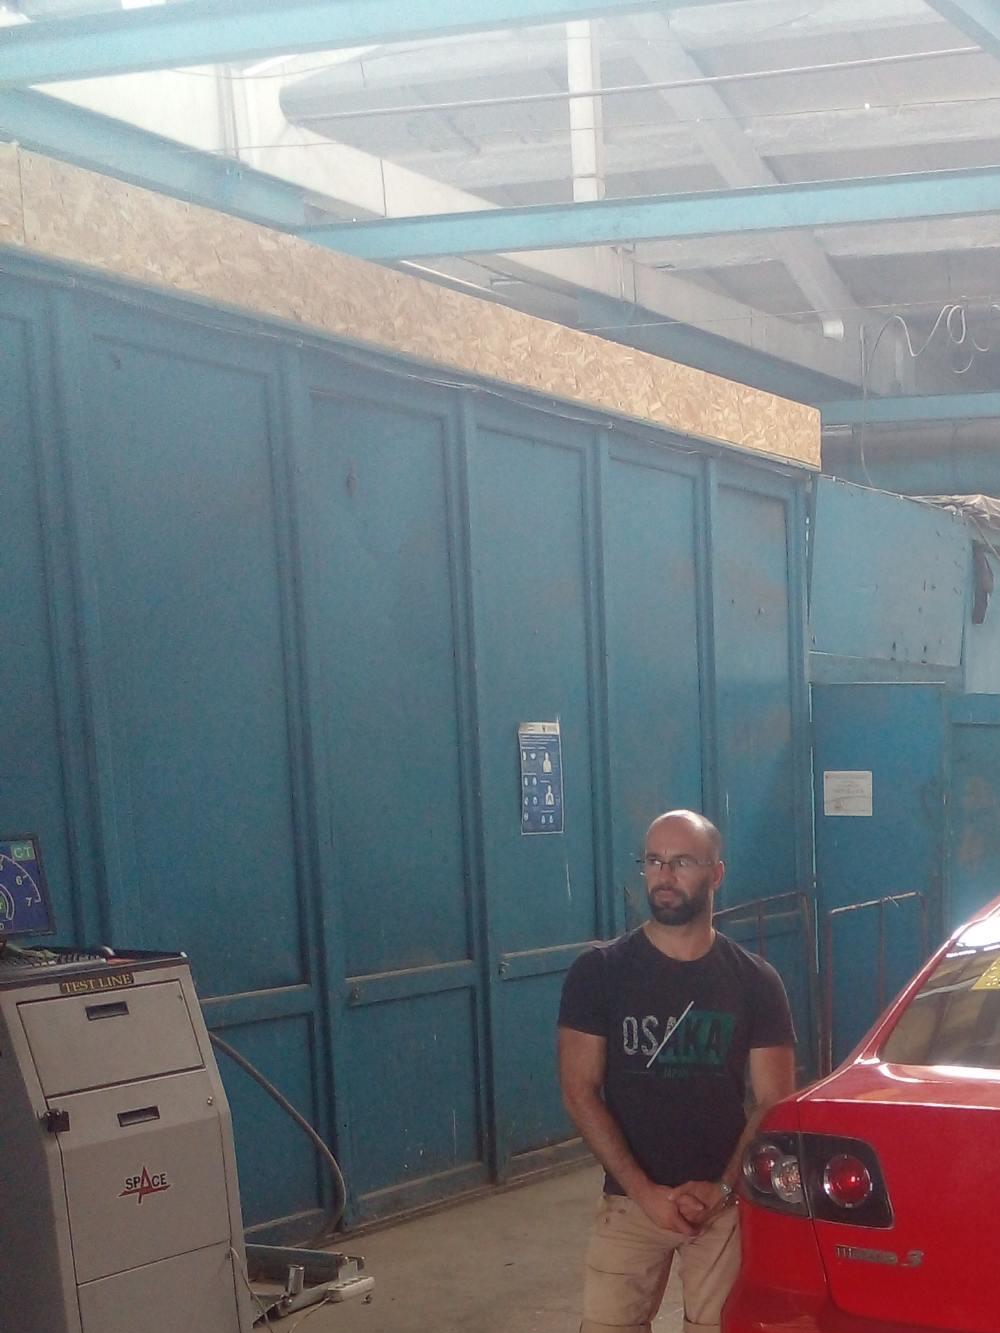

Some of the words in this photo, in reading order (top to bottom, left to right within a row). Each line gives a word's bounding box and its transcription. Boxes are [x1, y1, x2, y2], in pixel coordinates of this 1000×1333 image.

[16, 875, 23, 886] 6
[26, 896, 33, 907] 7
[62, 979, 96, 993] TEST
[99, 973, 131, 988] LINE
[124, 1166, 168, 1191] SPACE
